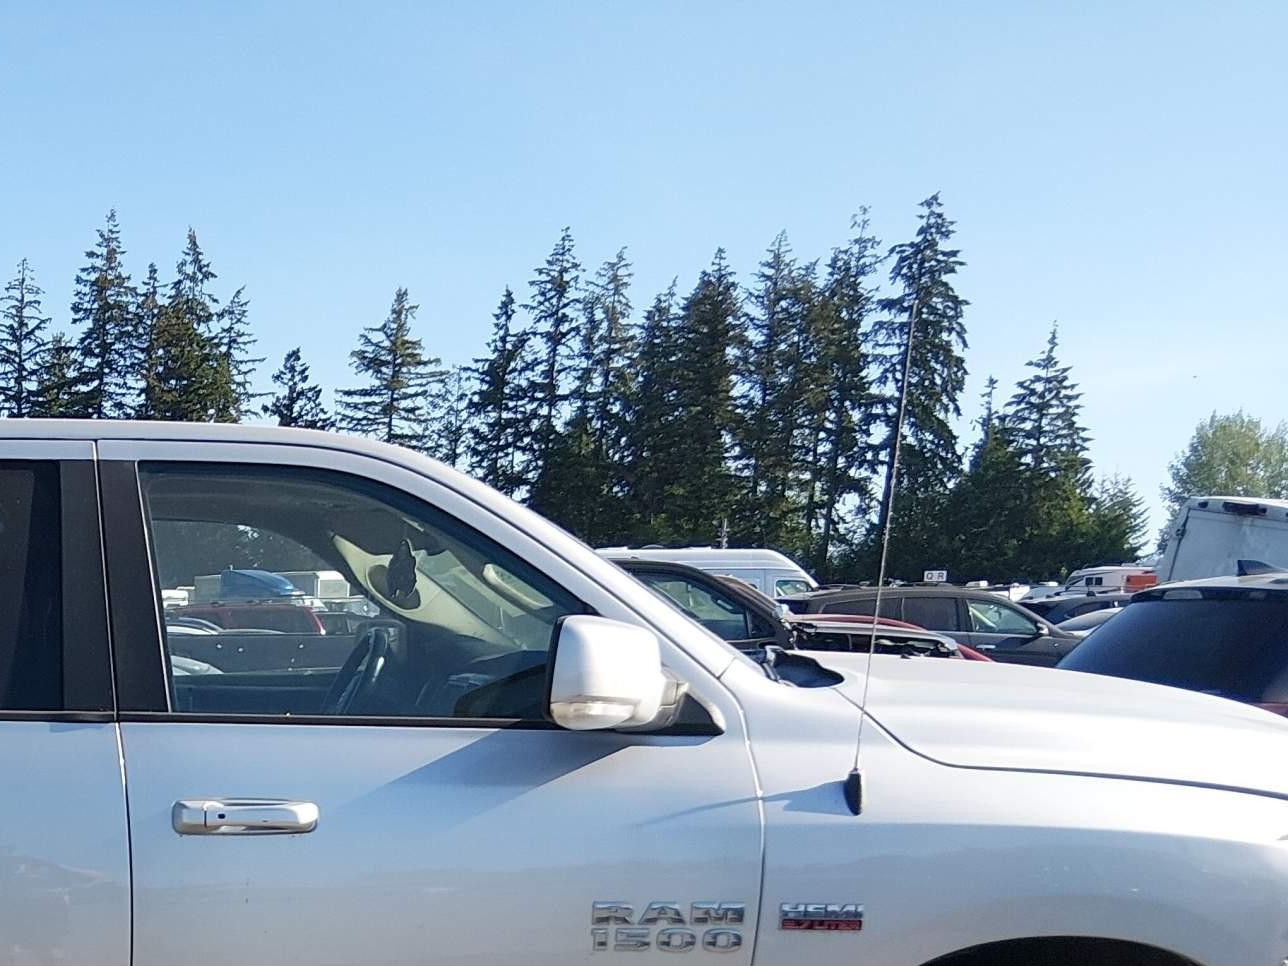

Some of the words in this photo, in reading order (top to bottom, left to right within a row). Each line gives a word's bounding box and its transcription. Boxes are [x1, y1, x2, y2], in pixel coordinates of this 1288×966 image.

[591, 901, 746, 925] RAM
[779, 902, 865, 919] HEMI
[591, 928, 743, 952] 1500
